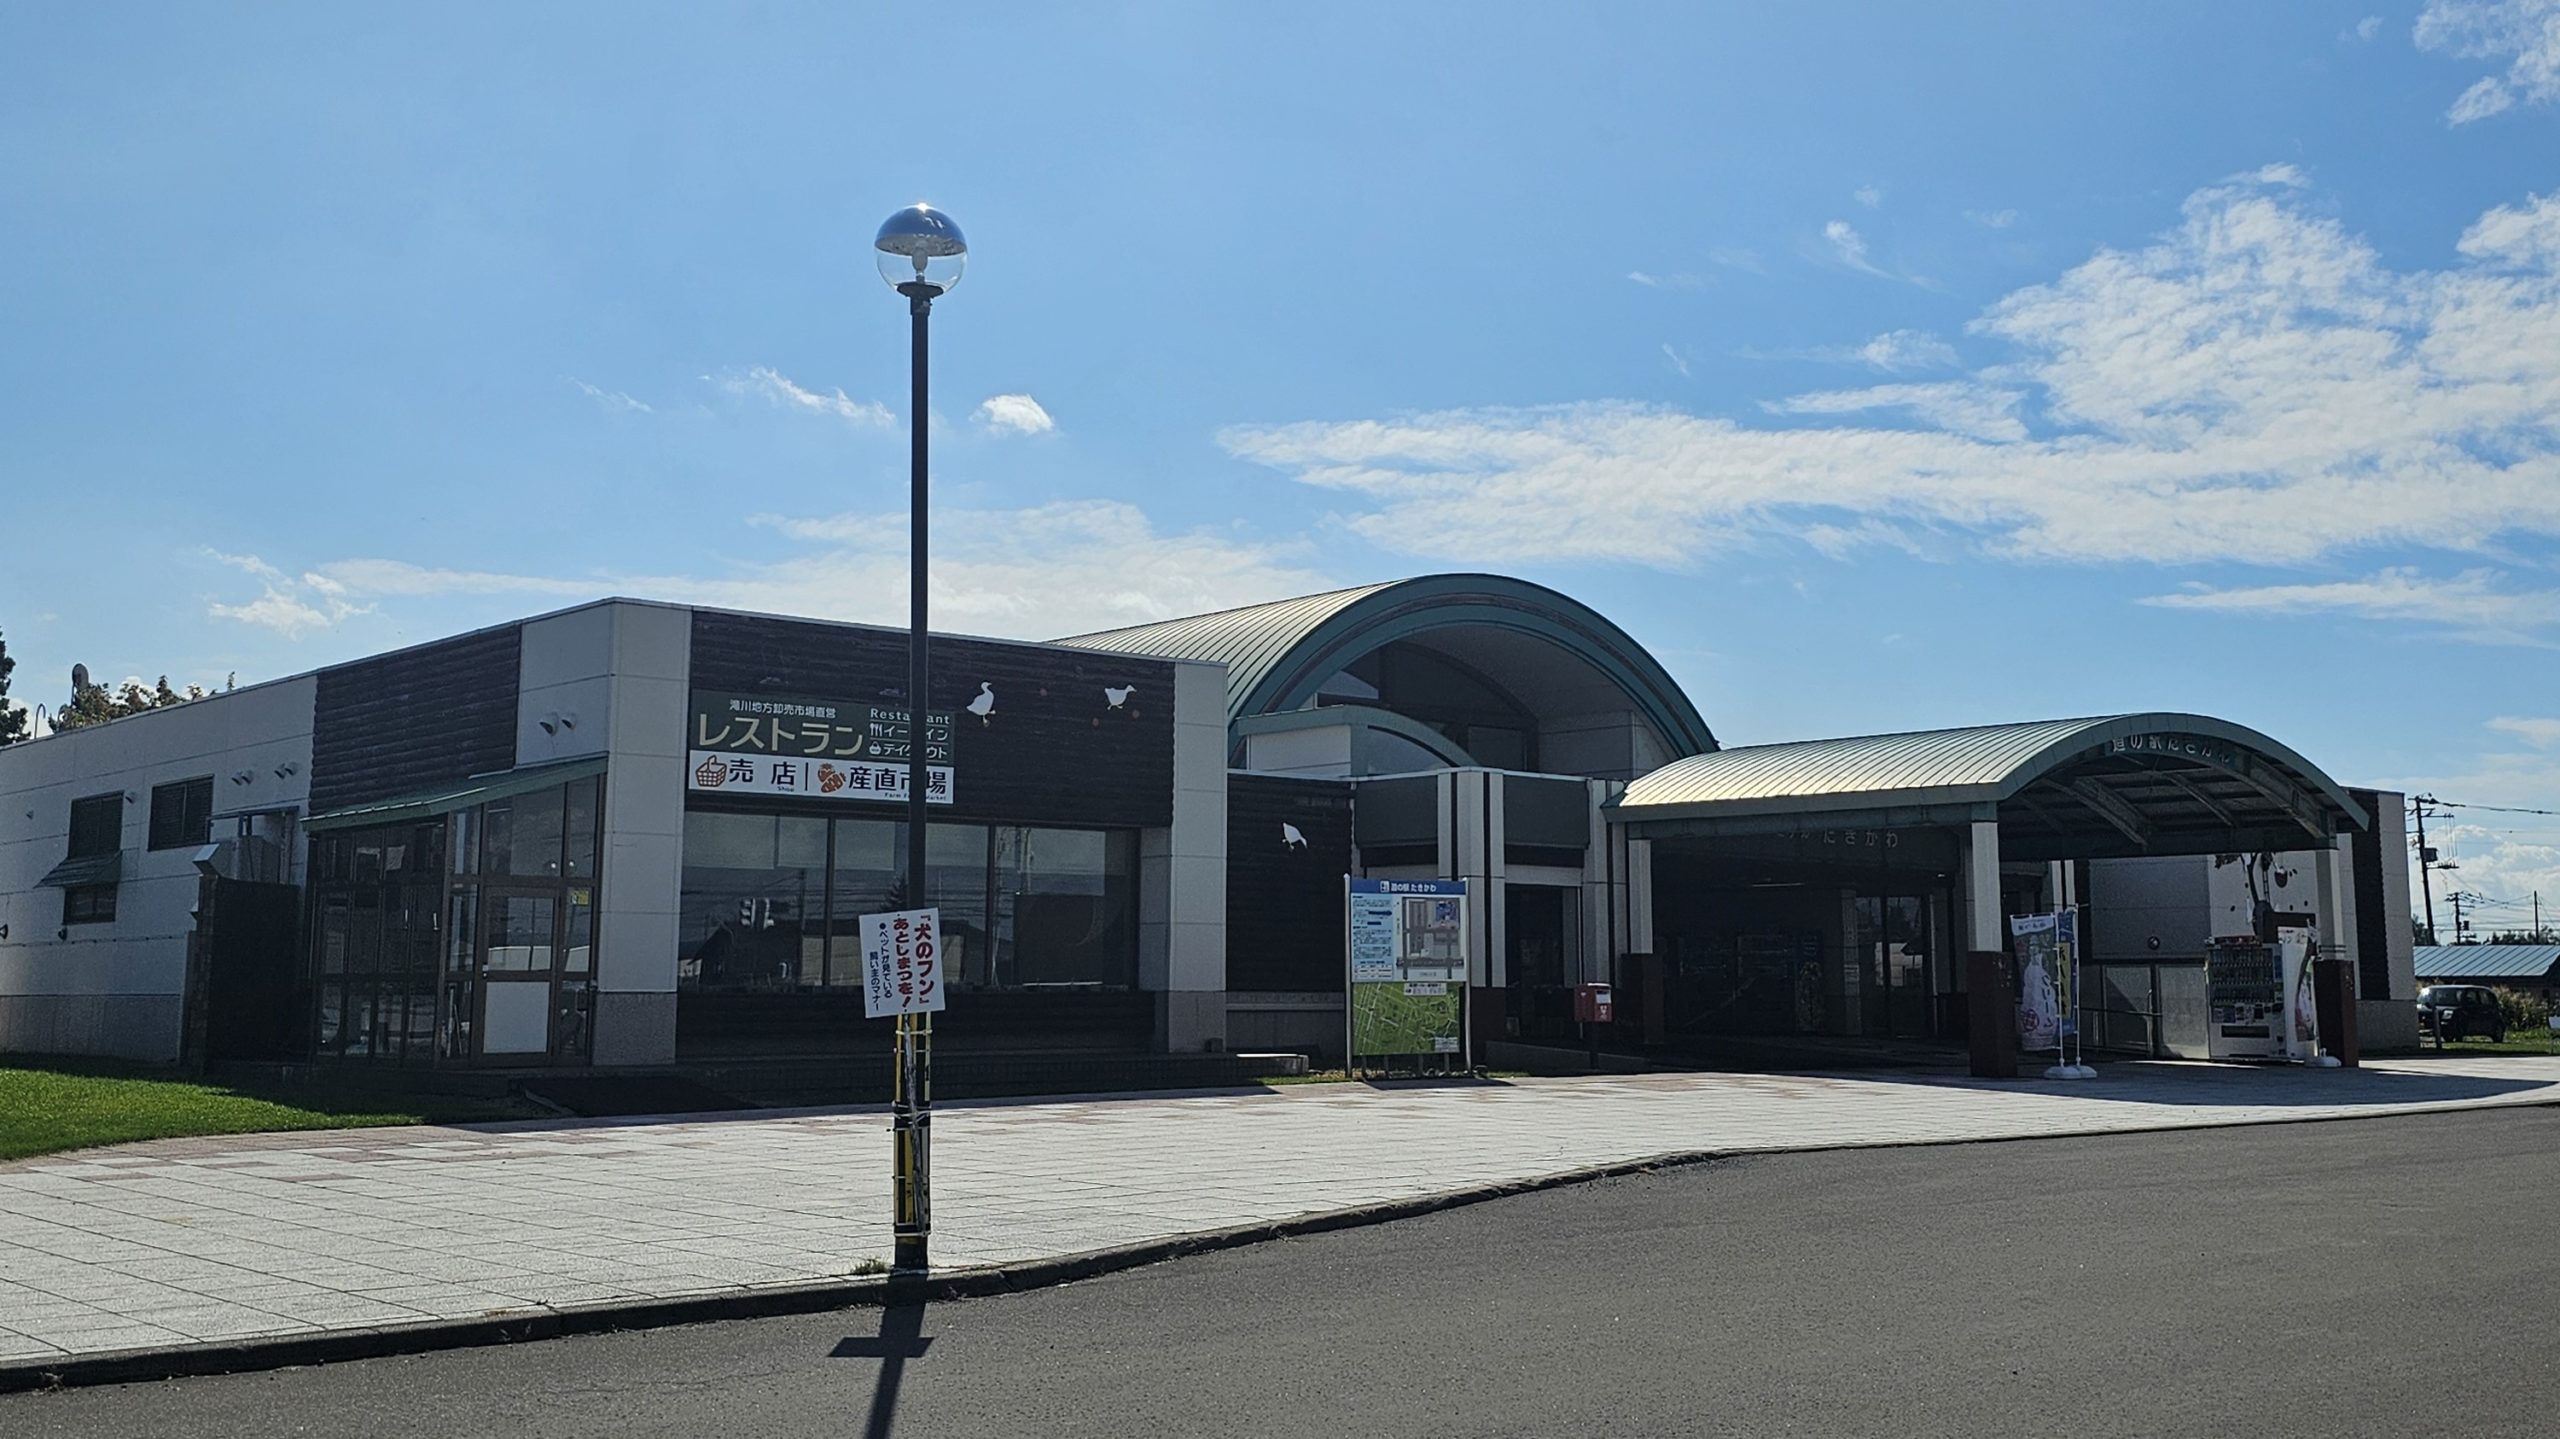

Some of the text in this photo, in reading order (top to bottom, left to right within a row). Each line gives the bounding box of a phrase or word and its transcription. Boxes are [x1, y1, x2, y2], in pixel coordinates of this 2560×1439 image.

[870, 707, 950, 724] Restaant
[698, 712, 864, 756] レストラン
[883, 725, 949, 741] イーイン
[883, 743, 948, 759] テイウト
